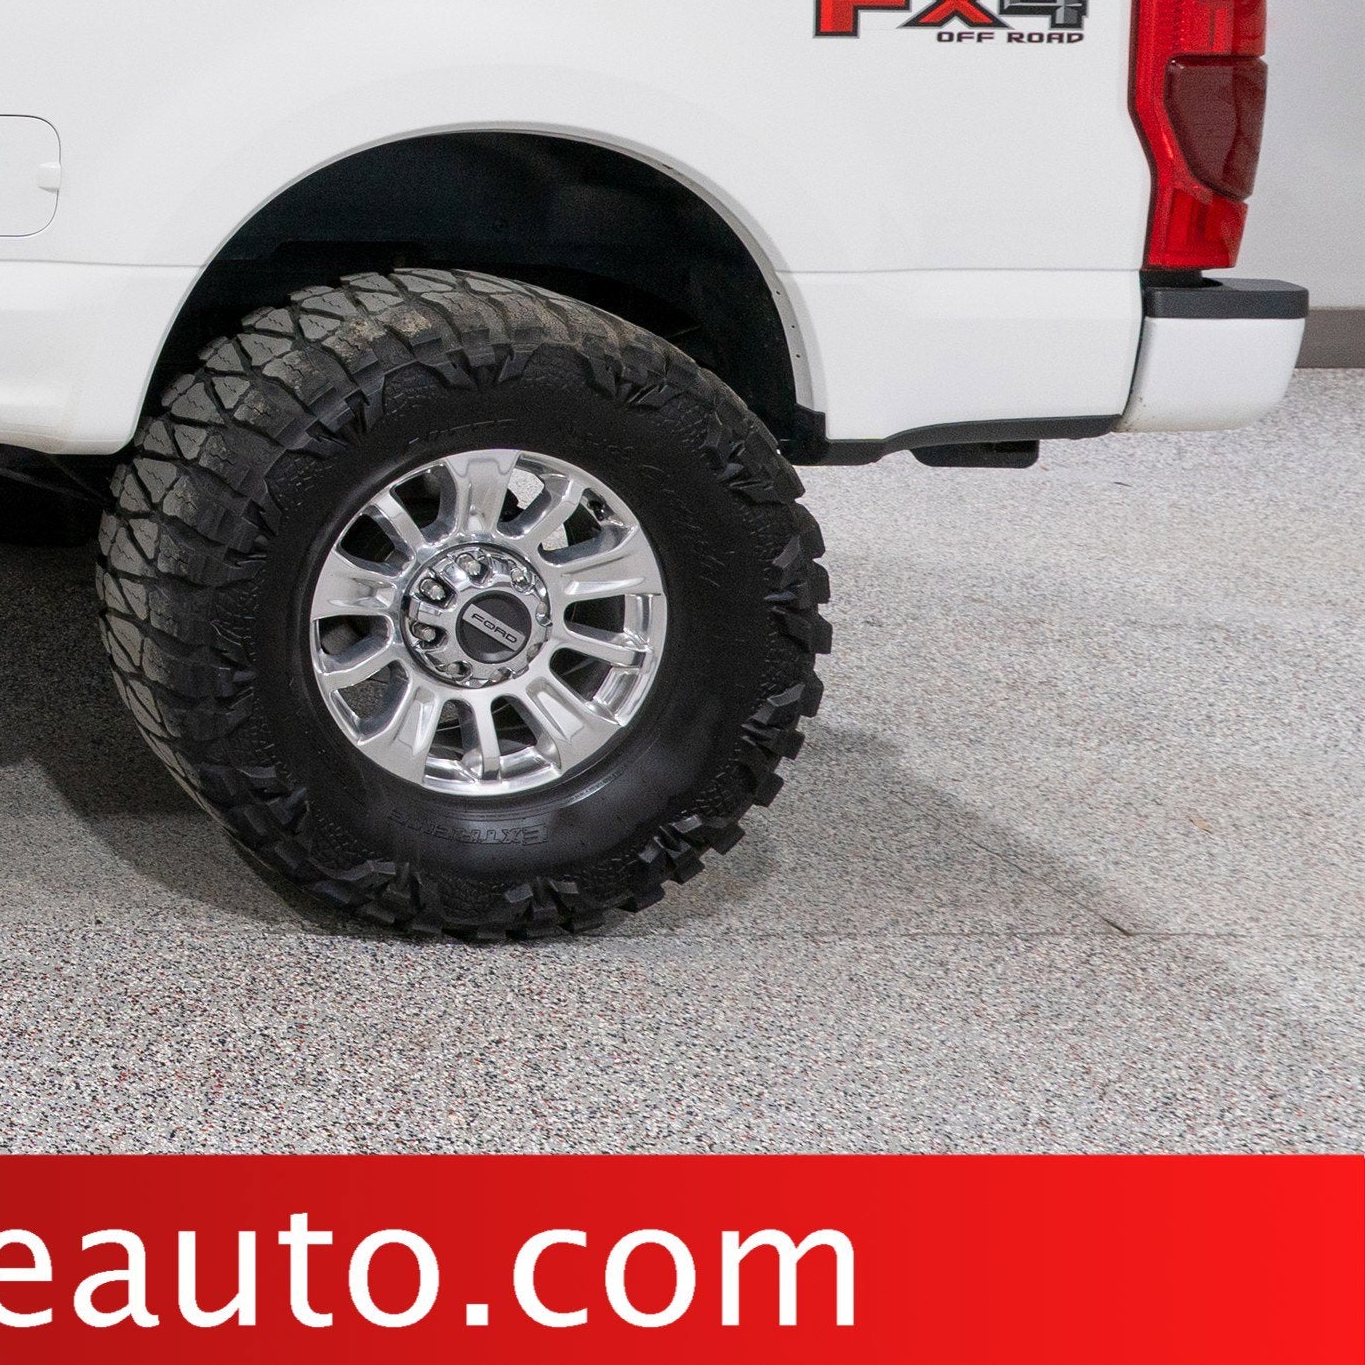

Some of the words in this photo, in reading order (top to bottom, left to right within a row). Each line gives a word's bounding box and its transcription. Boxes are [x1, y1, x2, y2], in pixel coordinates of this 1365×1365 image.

[936, 31, 996, 43] OFF
[1007, 32, 1084, 44] ROAD
[471, 613, 518, 644] FORD
